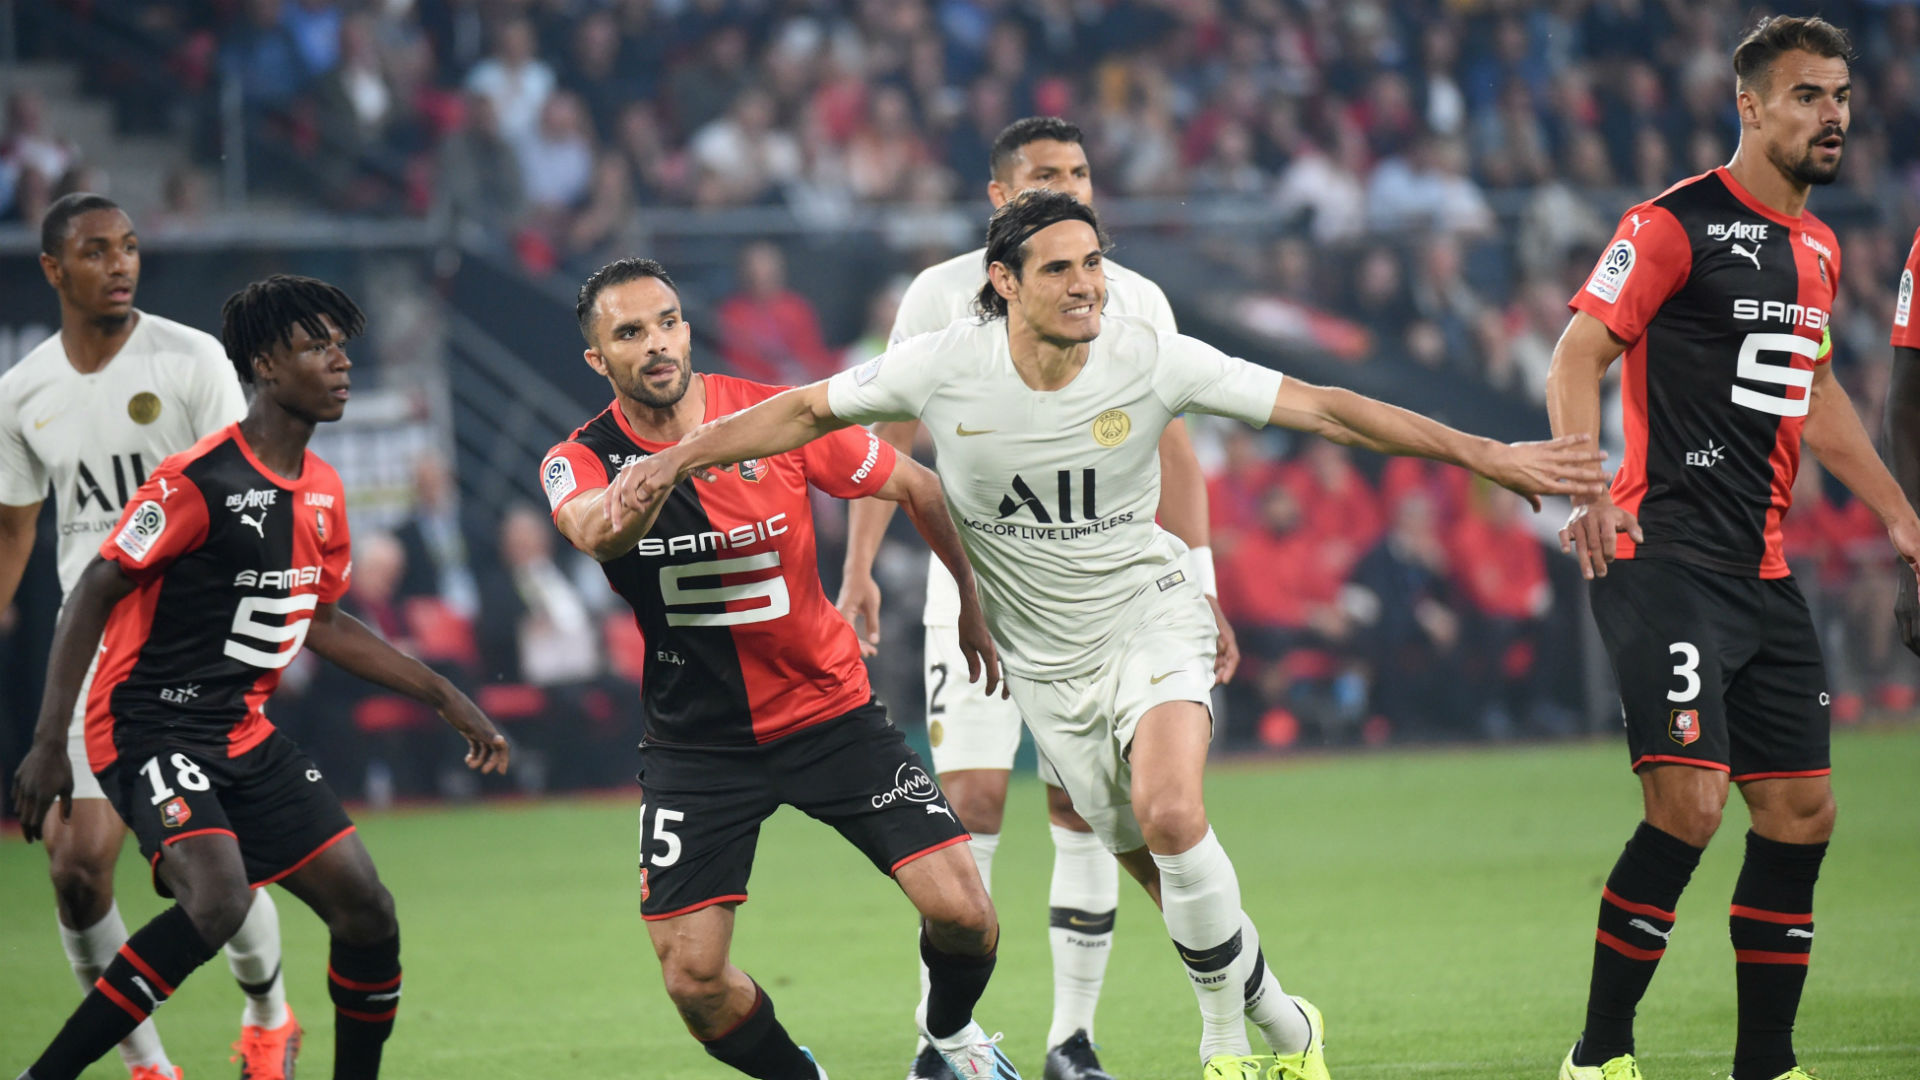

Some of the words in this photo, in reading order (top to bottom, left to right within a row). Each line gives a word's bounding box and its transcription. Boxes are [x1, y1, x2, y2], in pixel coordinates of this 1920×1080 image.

[638, 512, 789, 556] SAMSIC
[963, 517, 1017, 537] ACCOR
[1021, 527, 1057, 540] LIVE
[1061, 511, 1135, 541] LIMITLESS
[233, 565, 323, 590] SAMSI
[929, 663, 949, 715] 2
[1666, 641, 1701, 703] 3
[138, 752, 211, 806] 18
